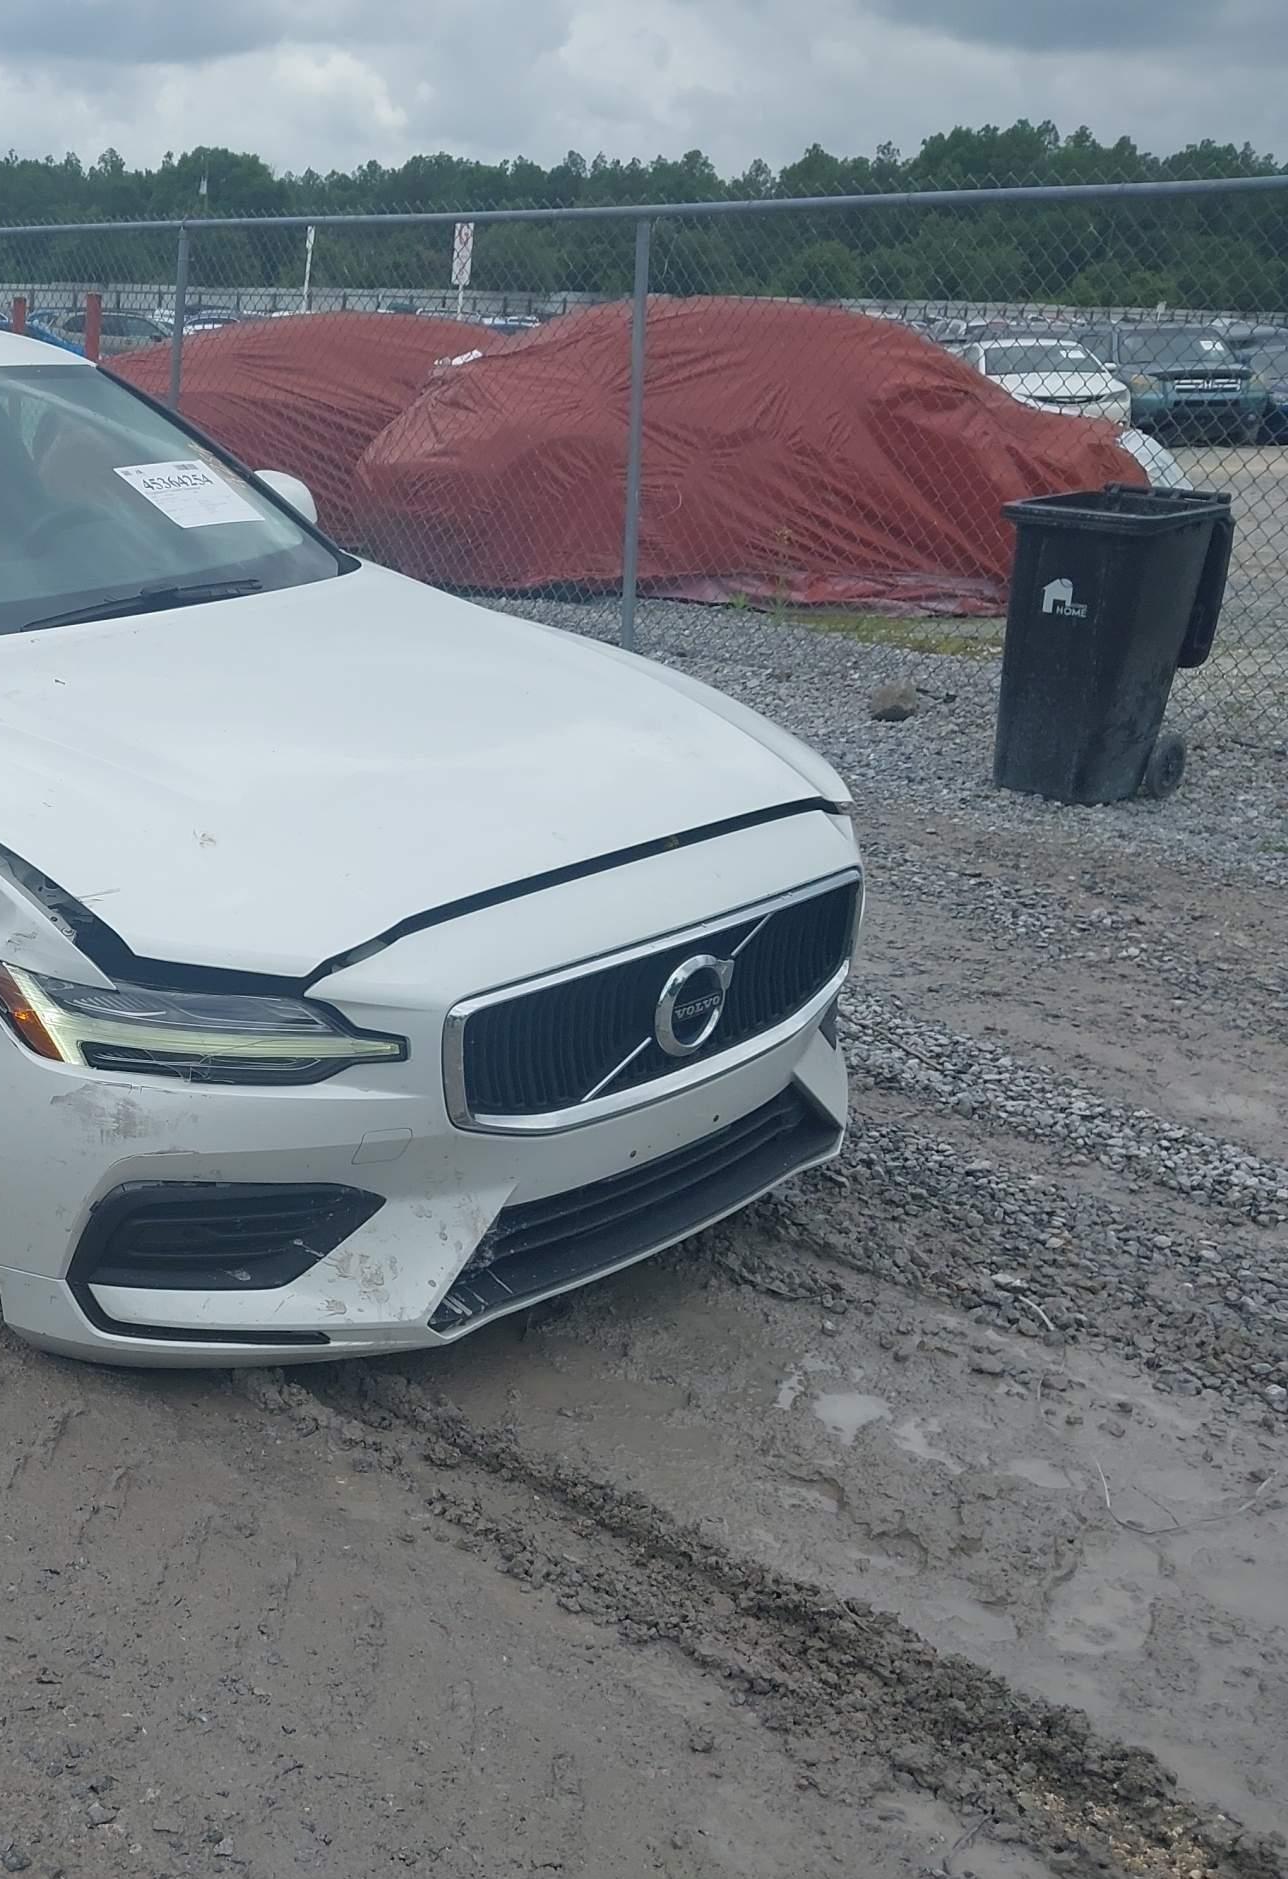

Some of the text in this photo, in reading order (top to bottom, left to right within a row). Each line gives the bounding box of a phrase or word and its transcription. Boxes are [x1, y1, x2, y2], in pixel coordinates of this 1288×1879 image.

[142, 473, 214, 491] 45364254
[1056, 605, 1087, 618] HOME
[674, 995, 720, 1019] VOLVO
